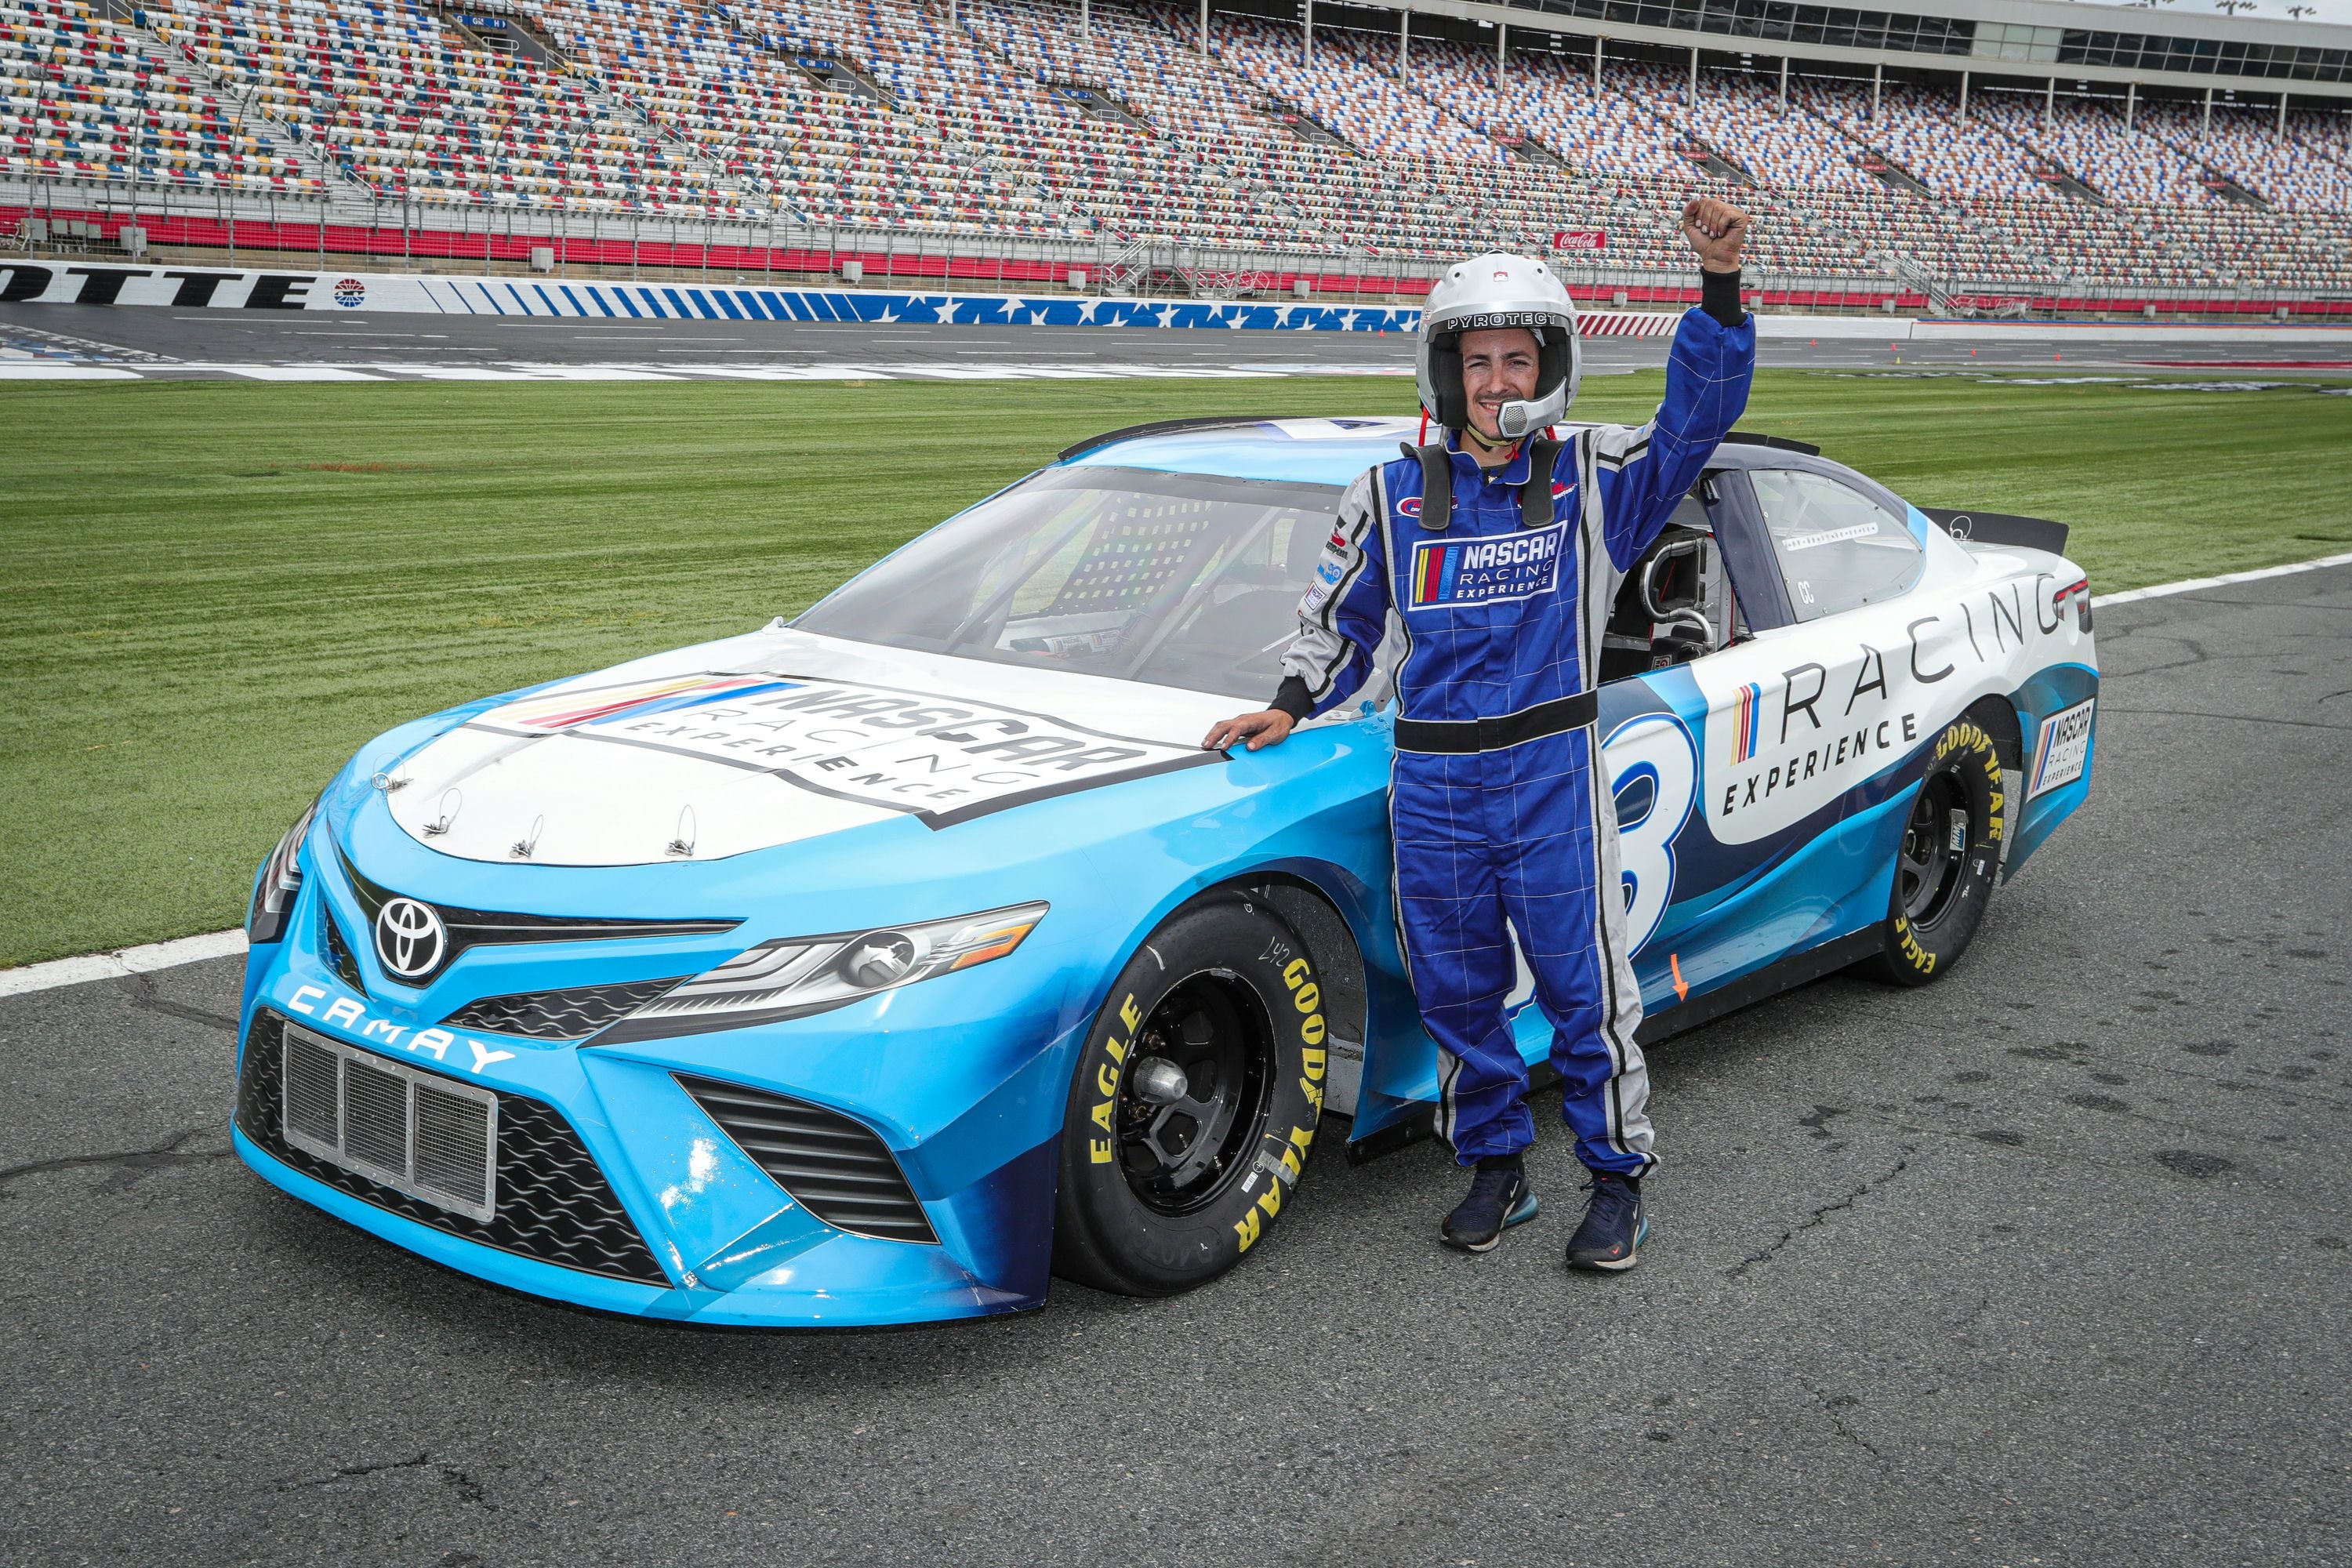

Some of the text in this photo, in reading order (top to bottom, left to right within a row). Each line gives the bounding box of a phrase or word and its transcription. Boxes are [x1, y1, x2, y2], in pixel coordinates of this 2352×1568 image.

[1447, 312, 1556, 329] PYROTECT
[1459, 560, 1553, 585] RACING
[1463, 532, 1558, 569] NASCAR
[1456, 575, 1548, 598] EXPERIENCE
[1780, 572, 2060, 745] RACING
[684, 708, 1041, 784] RACING
[751, 689, 1147, 771] NASCAR
[2053, 706, 2090, 749] NASCAR
[624, 721, 971, 799] EXPERIENCE
[1722, 713, 1918, 816] EXPERIENCE
[2042, 760, 2082, 786] EXPERIENCE
[2048, 740, 2085, 767] RACING
[1895, 913, 1936, 973] EAGLE
[1091, 993, 1142, 1164] EAGLE
